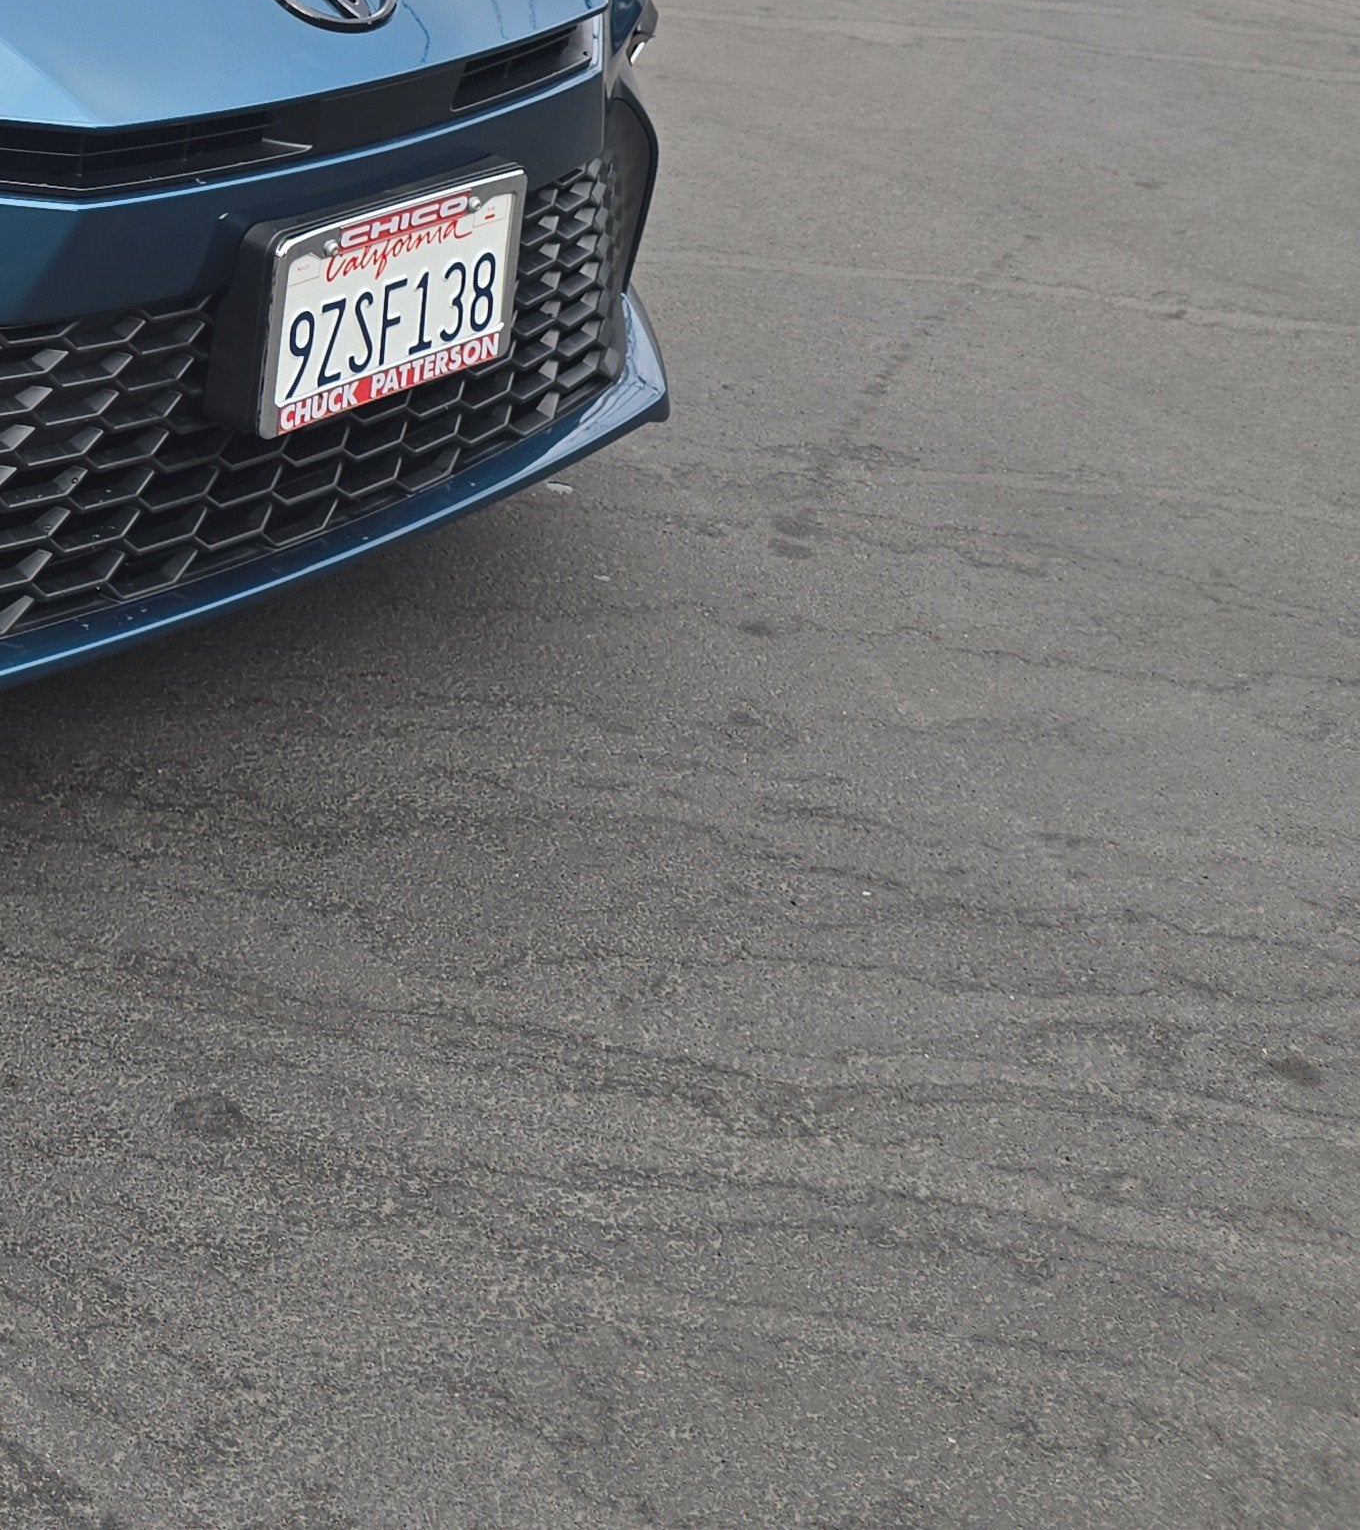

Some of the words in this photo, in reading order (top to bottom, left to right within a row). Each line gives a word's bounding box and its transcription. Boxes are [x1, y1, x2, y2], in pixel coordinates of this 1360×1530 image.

[325, 220, 472, 282] California
[340, 194, 469, 249] CHICO
[284, 251, 497, 401] 9ZSF138
[280, 384, 359, 432] CHUCK
[369, 332, 500, 400] PATTERSON
